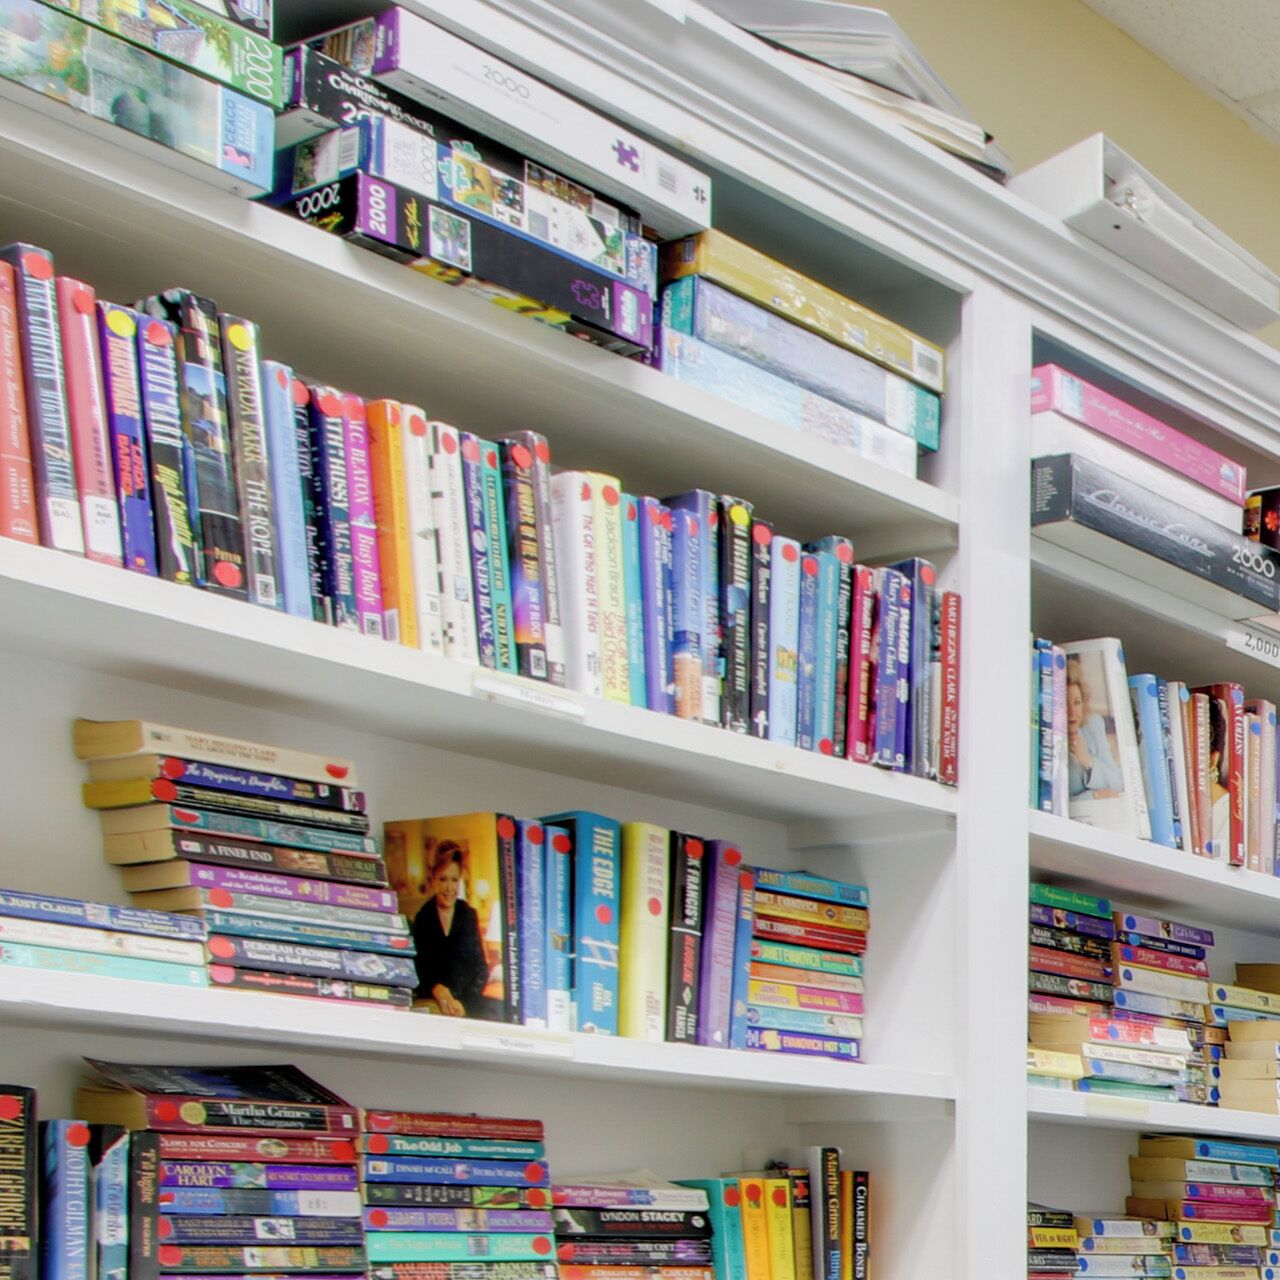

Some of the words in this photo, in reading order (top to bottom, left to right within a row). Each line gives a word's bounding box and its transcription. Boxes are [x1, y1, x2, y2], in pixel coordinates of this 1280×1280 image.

[244, 36, 272, 101] 2000
[482, 66, 530, 99] 2000
[369, 185, 386, 235] 2000
[236, 350, 256, 420] NEVADA
[242, 419, 259, 466] BARR
[245, 478, 262, 509] THE
[250, 507, 272, 554] ROPE
[1231, 545, 1276, 578] 2000
[1245, 633, 1278, 659] 2,000
[209, 845, 216, 856] A
[217, 845, 248, 861] FINER
[249, 848, 273, 863] END
[592, 828, 614, 862] THE
[592, 861, 614, 899] EDGE
[220, 1104, 266, 1117] Martha
[267, 1106, 310, 1120] Grimes
[166, 1164, 227, 1177] CAROLYN
[177, 1174, 217, 1186] HART
[826, 1152, 839, 1201] Martha
[600, 1212, 640, 1223] LYNDON
[642, 1212, 685, 1223] STACEY
[828, 1199, 839, 1240] Grimes
